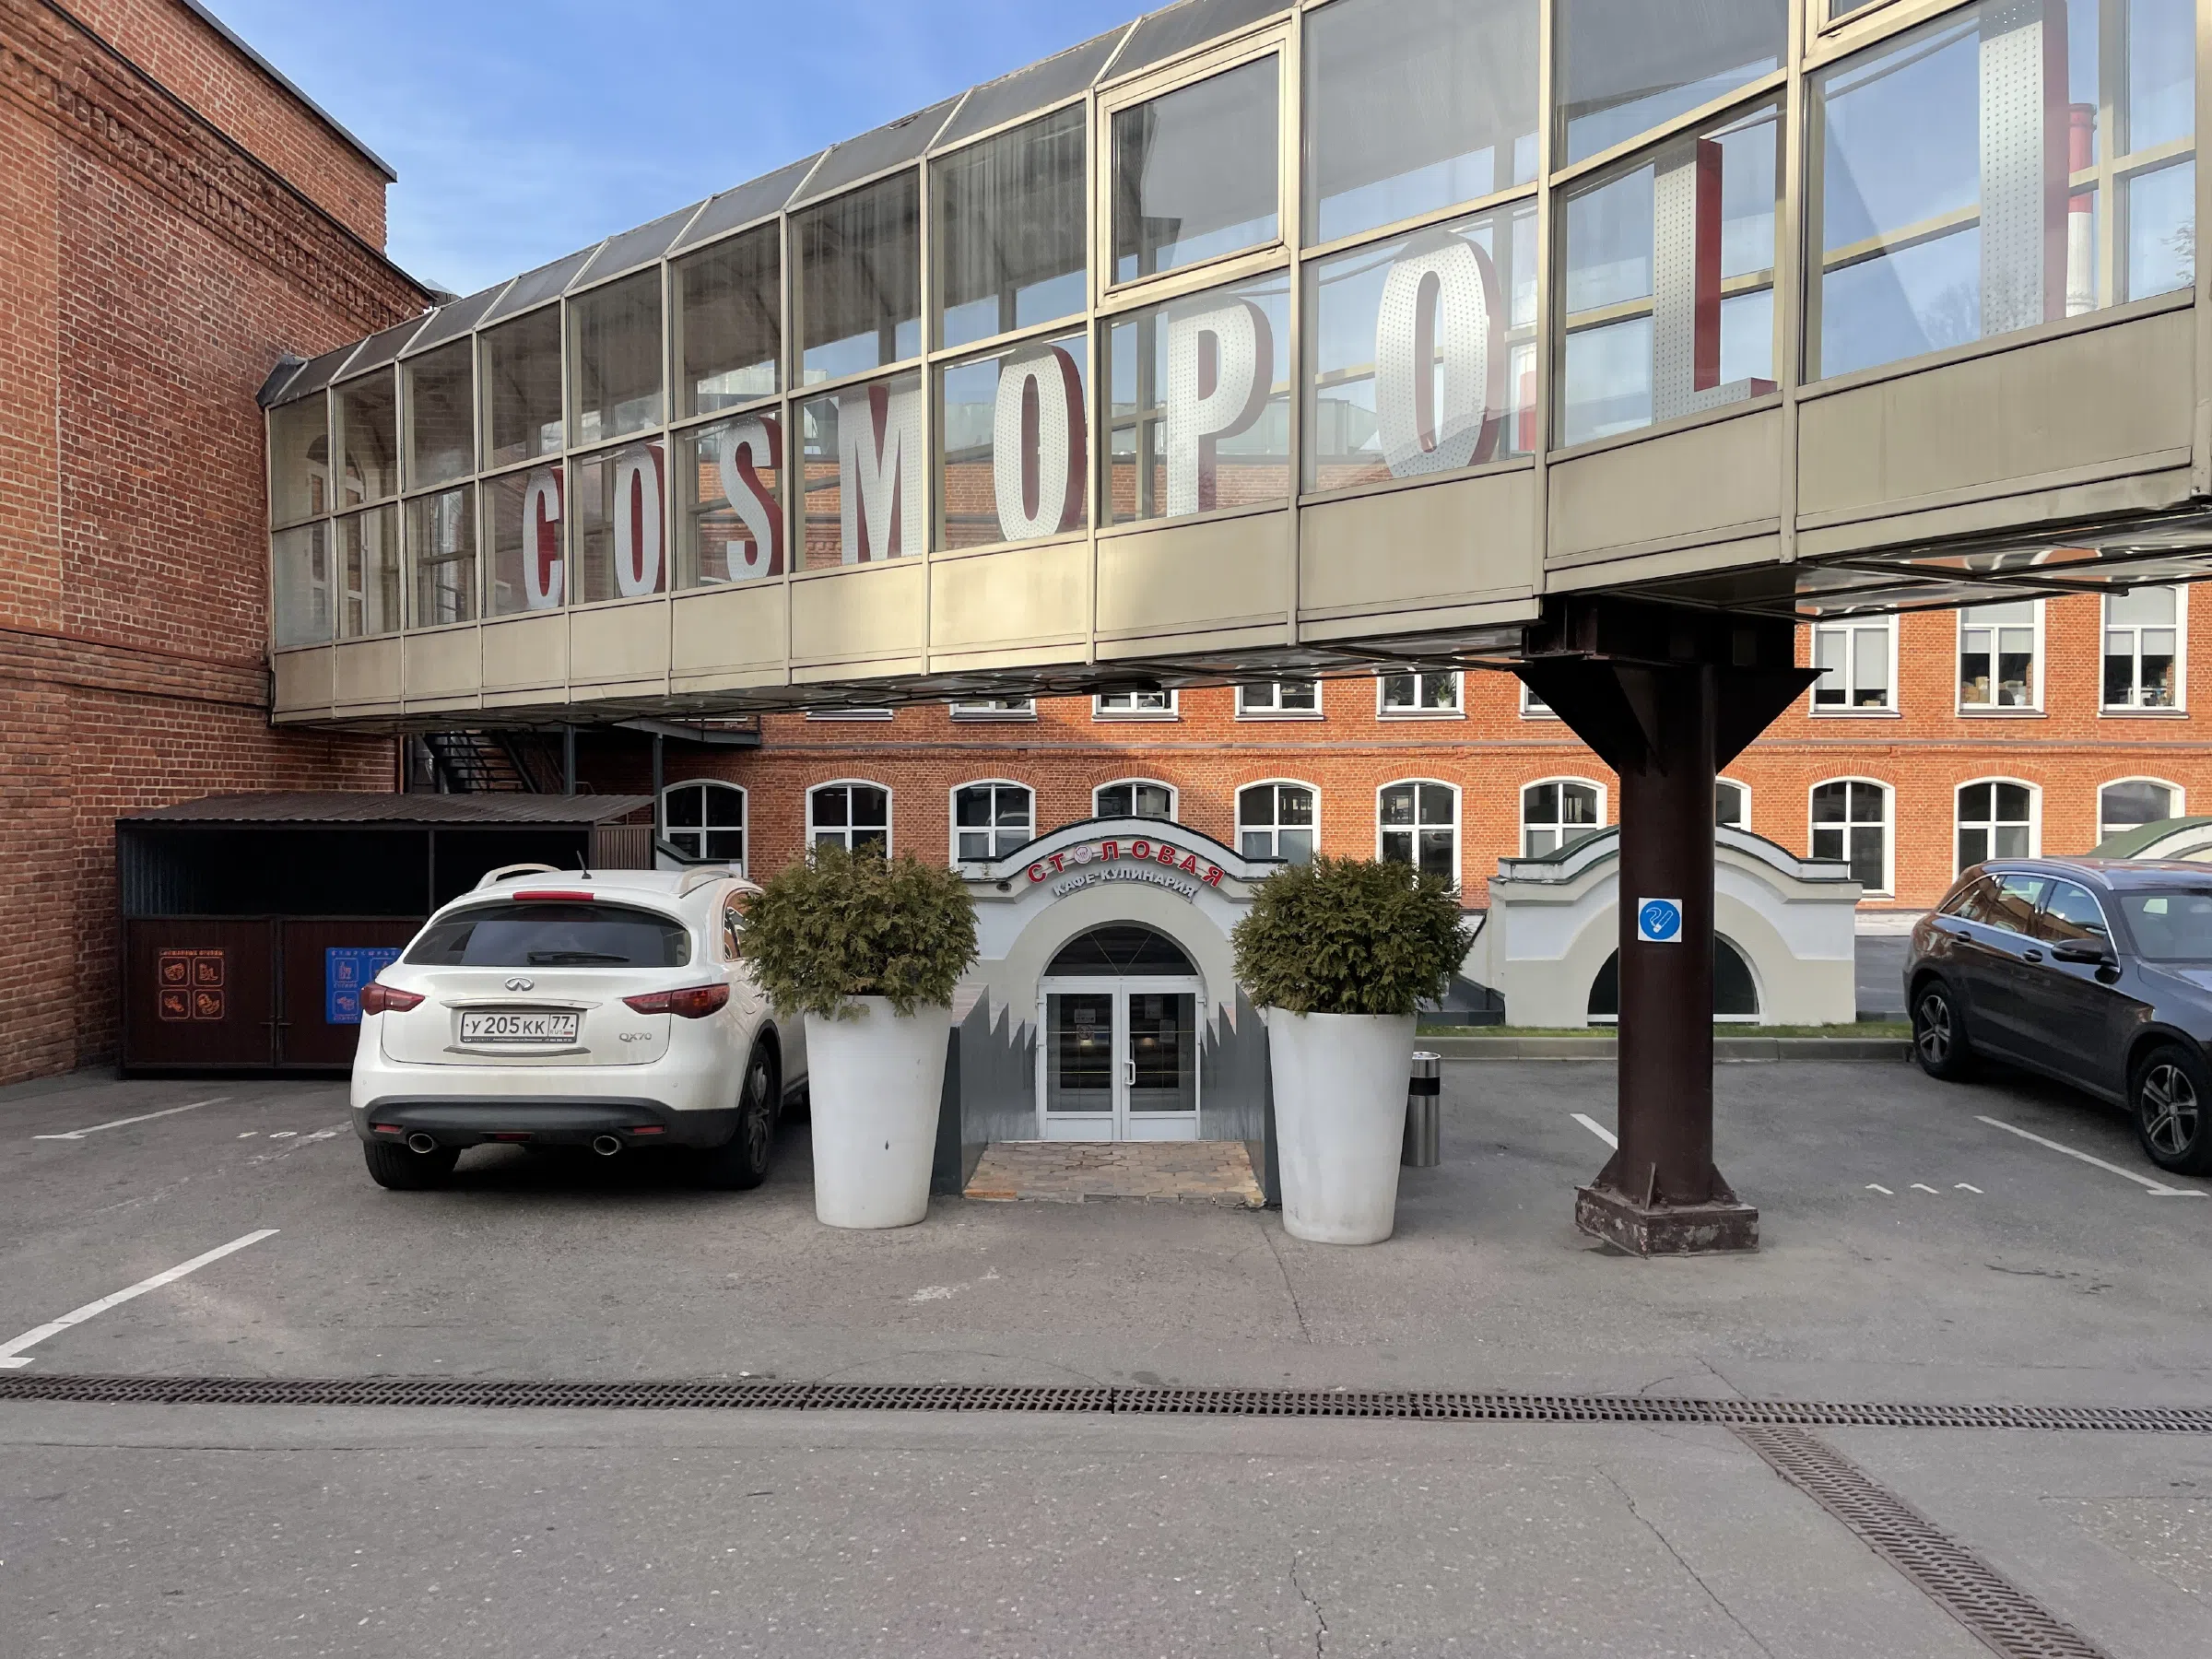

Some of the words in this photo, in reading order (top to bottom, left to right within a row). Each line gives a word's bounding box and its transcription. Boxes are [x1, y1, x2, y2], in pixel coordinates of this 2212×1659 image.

[1053, 867, 1197, 898] КАФЕ-КУЛИНАРИЯ
[552, 1016, 570, 1030] 77
[618, 1032, 653, 1042] QX70
